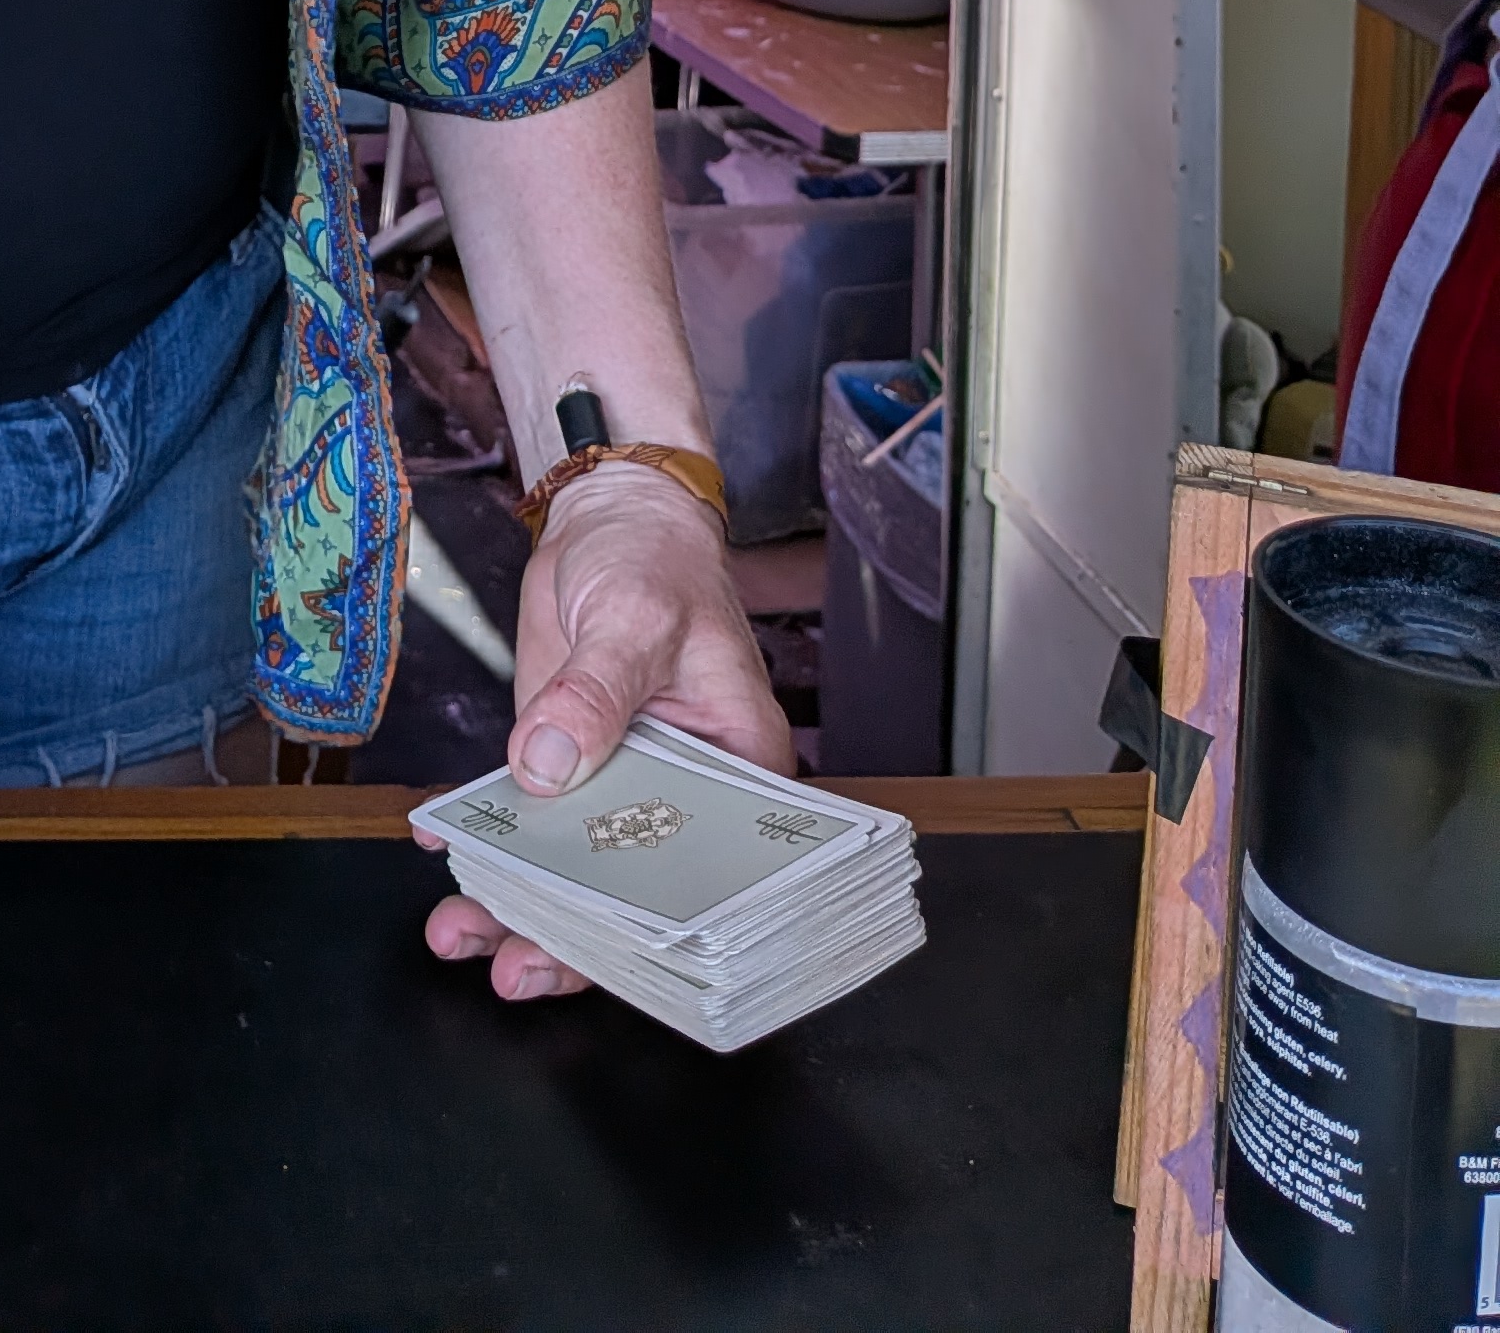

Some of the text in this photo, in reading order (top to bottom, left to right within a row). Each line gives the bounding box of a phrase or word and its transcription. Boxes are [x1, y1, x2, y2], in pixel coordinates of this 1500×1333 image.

[1268, 990, 1289, 1015] away
[1290, 1005, 1312, 1030] from
[1314, 1020, 1339, 1044] heat
[1274, 1026, 1306, 1059] gluten,
[1308, 1052, 1347, 1081] celery,
[1272, 1083, 1289, 1104] non
[1291, 1129, 1302, 1145] et
[1303, 1137, 1323, 1156] sec
[1459, 1155, 1488, 1170] B&M
[1271, 1160, 1293, 1187] soja,
[1295, 1179, 1334, 1210] sulfite.
[1274, 1147, 1287, 1165] du
[1288, 1159, 1326, 1191] gluten,
[1327, 1183, 1367, 1211] céleri,
[1296, 1148, 1310, 1165] du
[1311, 1158, 1343, 1183] soleil.
